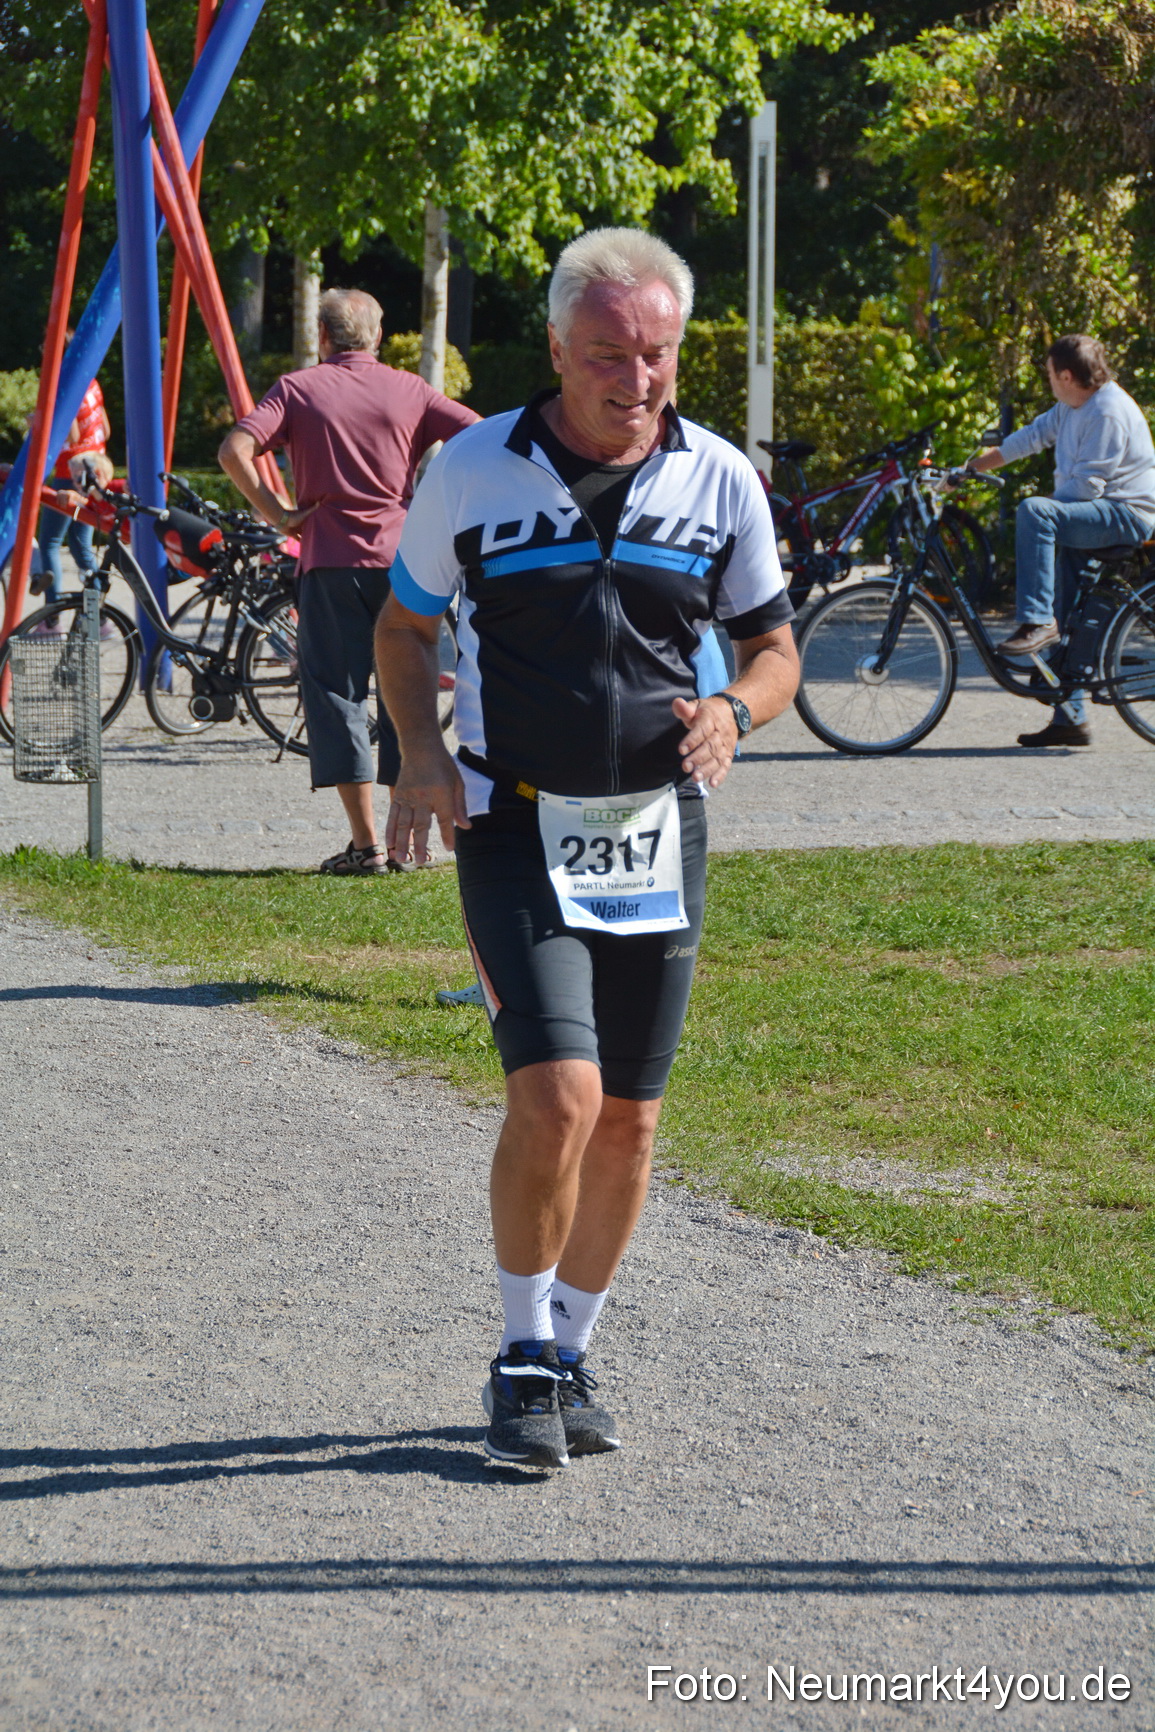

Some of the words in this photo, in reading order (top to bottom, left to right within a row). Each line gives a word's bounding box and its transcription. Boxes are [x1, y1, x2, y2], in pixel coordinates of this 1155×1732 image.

[560, 829, 661, 875] 2317
[608, 881, 644, 890] Neumarkt
[590, 901, 641, 918] Walter
